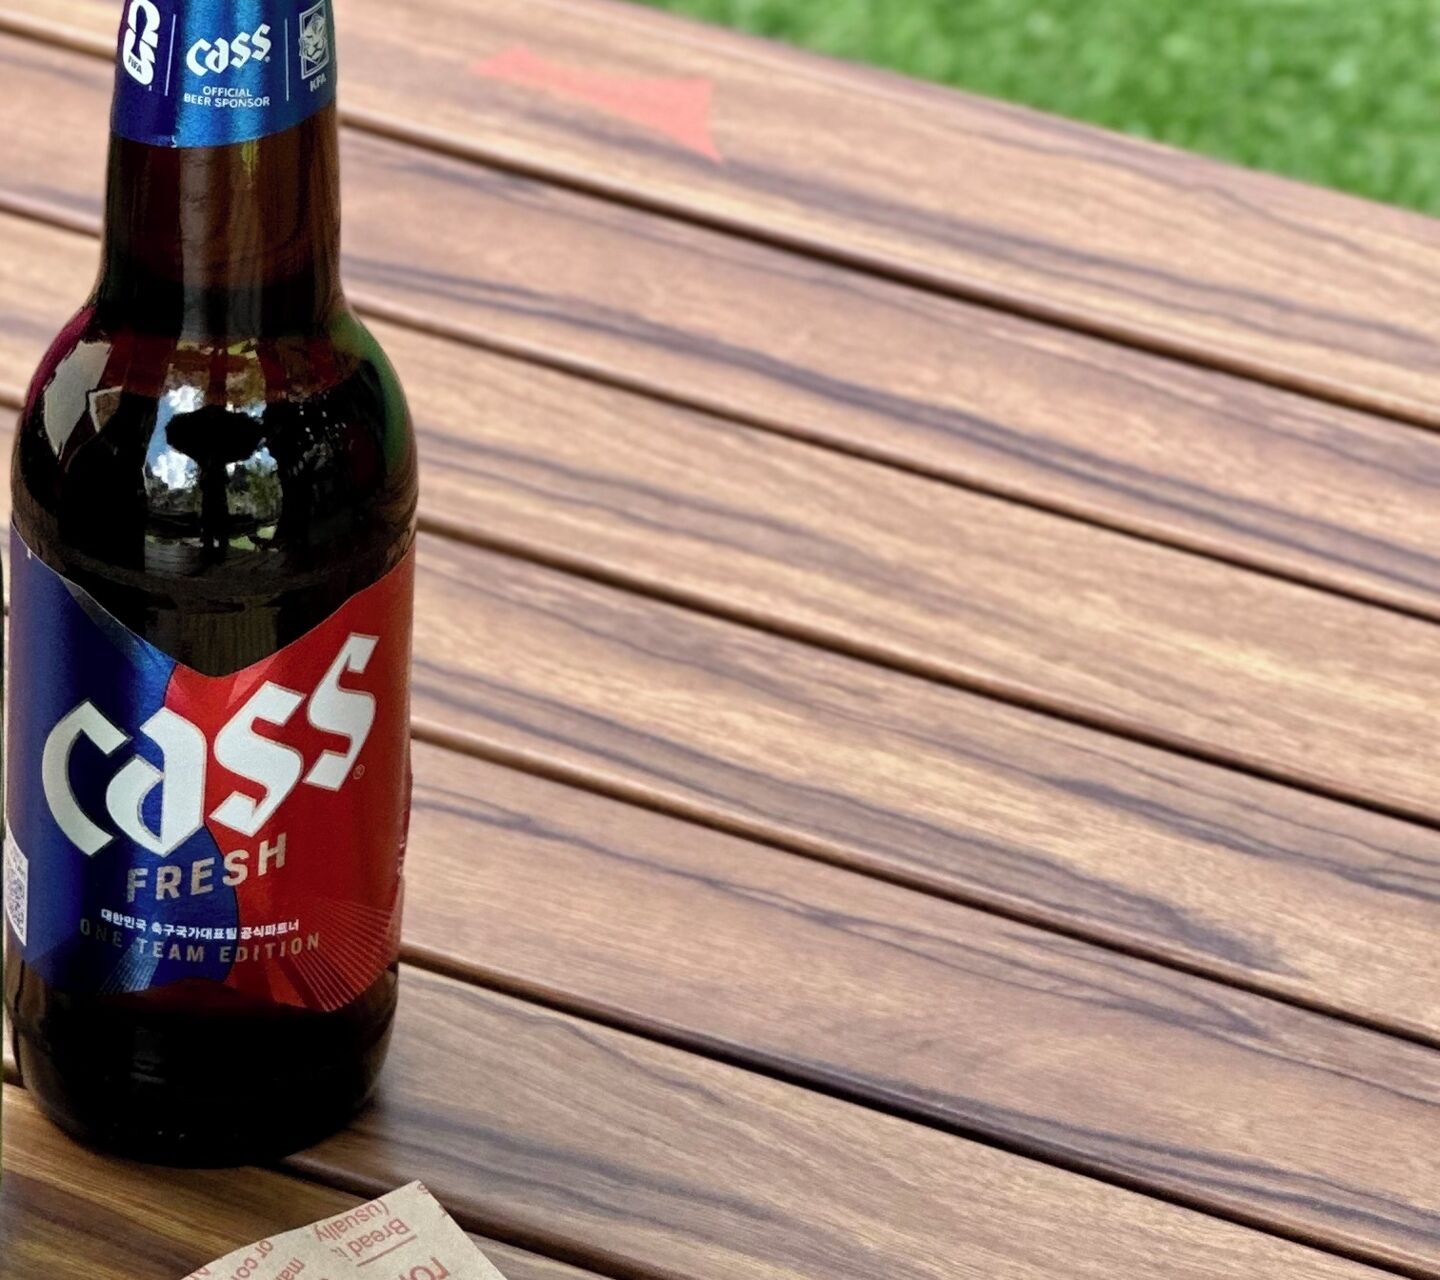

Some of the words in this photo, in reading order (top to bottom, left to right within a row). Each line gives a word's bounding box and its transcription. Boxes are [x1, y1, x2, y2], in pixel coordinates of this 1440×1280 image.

[127, 55, 143, 75] FIFA
[183, 92, 212, 106] BEER
[214, 96, 271, 110] SPONSOR
[202, 86, 252, 97] OFFICIAL
[126, 832, 288, 903] FRESH
[100, 908, 147, 932] 대한민국
[239, 919, 300, 939] 공식파트너
[79, 918, 123, 948] ONE
[135, 937, 206, 962] TEAM
[219, 932, 320, 963] EDITION
